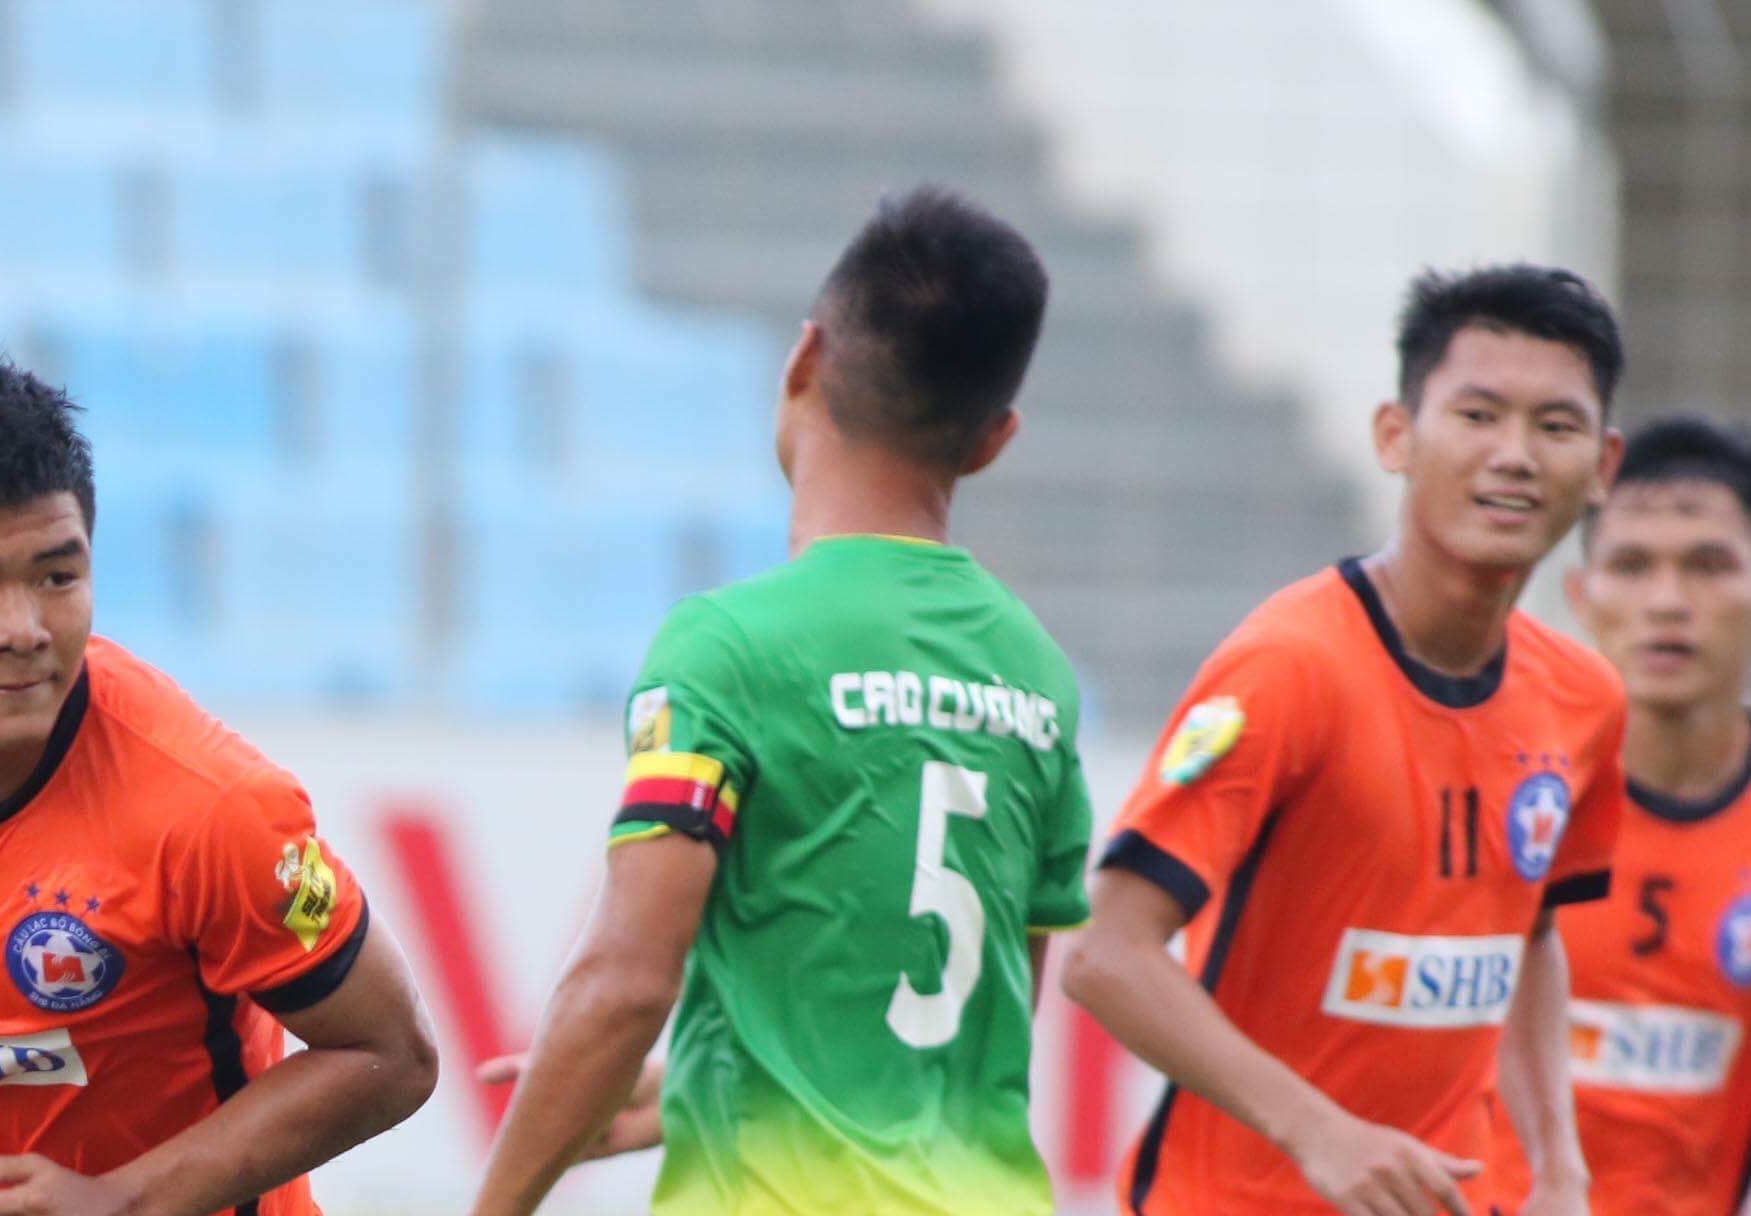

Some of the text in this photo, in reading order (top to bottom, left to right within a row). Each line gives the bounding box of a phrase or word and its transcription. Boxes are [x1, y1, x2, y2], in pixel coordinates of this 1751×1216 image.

[829, 670, 924, 729] CAO
[1438, 786, 1480, 879] 11
[885, 760, 989, 1050] 5
[1630, 874, 1677, 958] 5
[1410, 951, 1512, 1010] SHB
